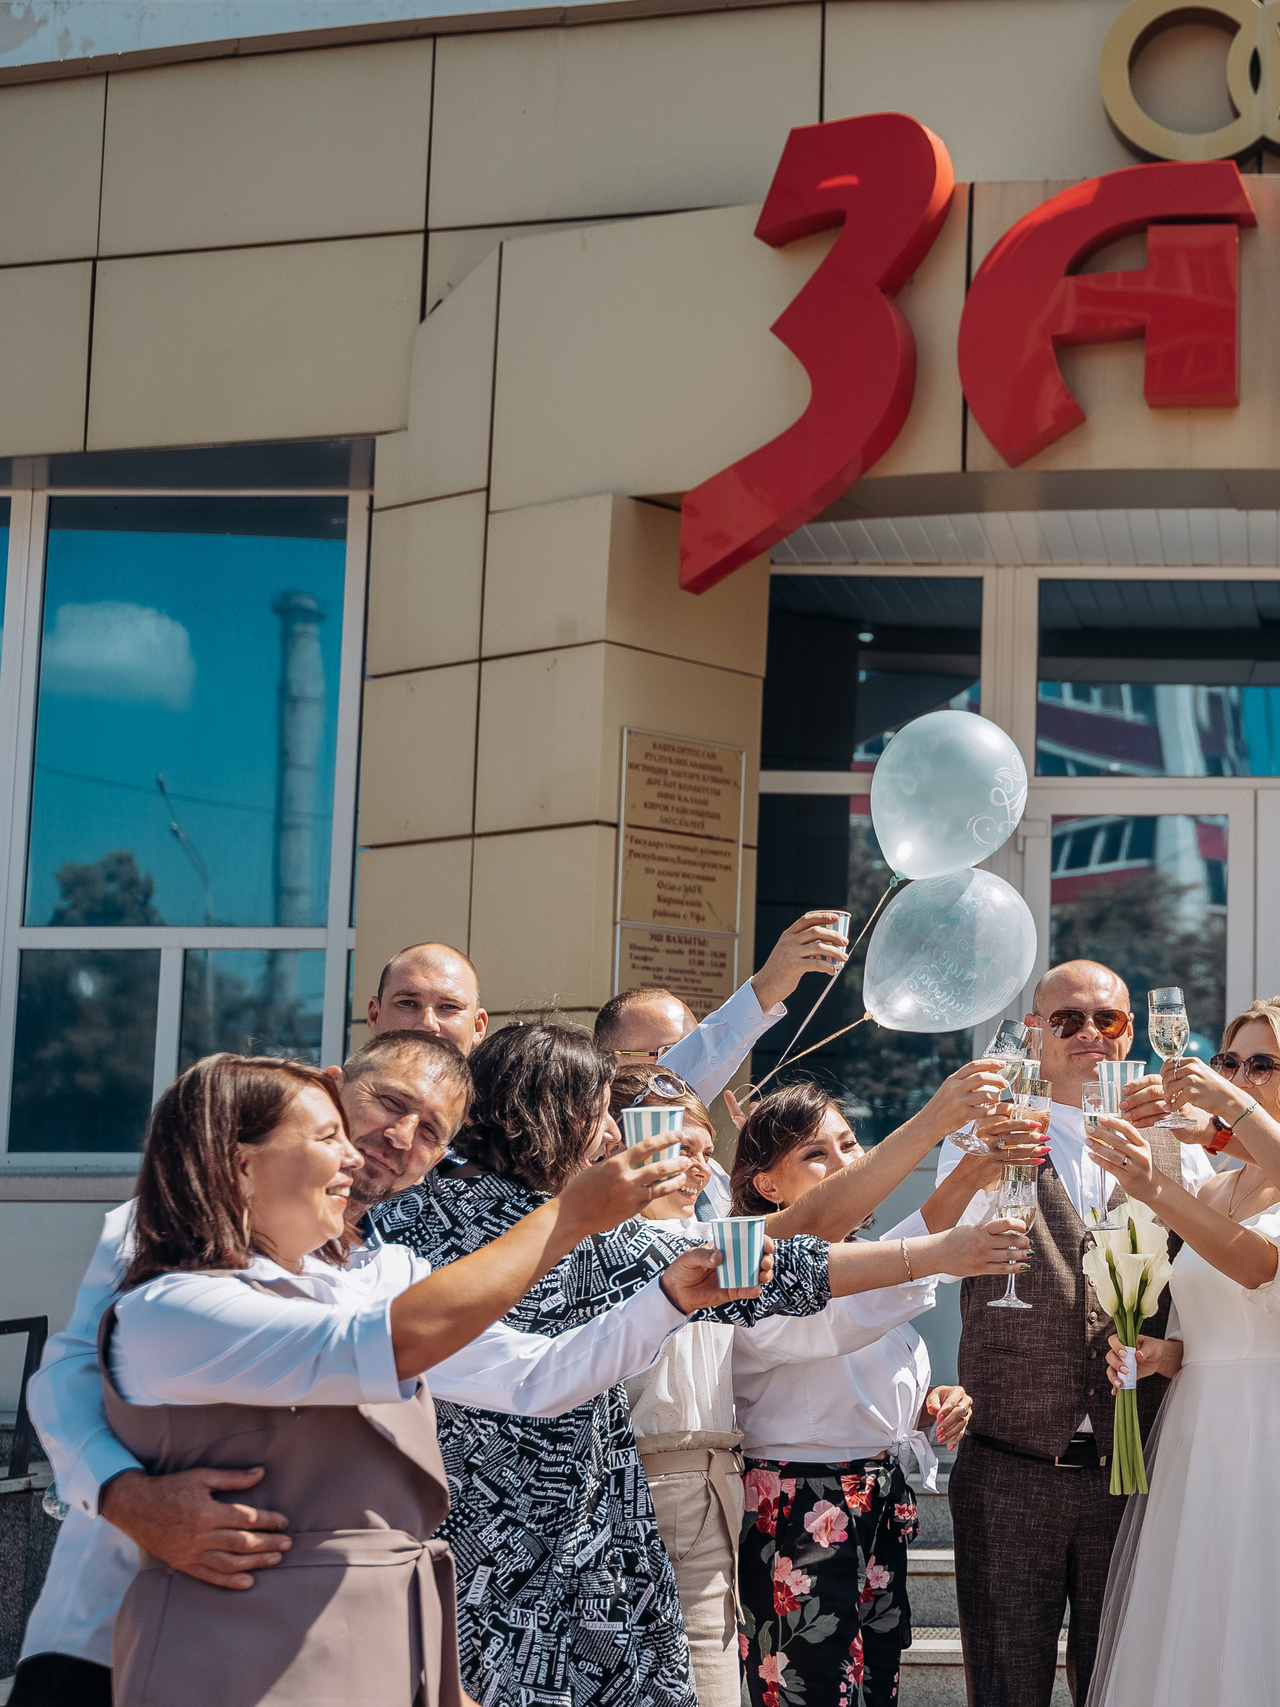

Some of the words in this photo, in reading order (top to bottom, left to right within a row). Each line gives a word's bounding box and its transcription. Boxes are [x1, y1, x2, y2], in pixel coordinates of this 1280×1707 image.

[500, 1203, 525, 1219] Towar
[425, 1240, 452, 1261] DESIGN
[477, 1514, 506, 1540] DESIGN
[483, 1529, 500, 1547] FOR
[578, 1550, 592, 1564] The
[469, 1568, 489, 1602] TODAY
[486, 1562, 516, 1592] The
[541, 1650, 551, 1660] OF
[537, 1660, 548, 1685] SPREAD
[554, 1663, 564, 1689] ALWAYS
[559, 1652, 566, 1662] BE
[578, 1661, 603, 1677] epic.
[600, 1689, 613, 1705] NEVER
[613, 1678, 626, 1690] GIVE
[624, 1668, 631, 1678] UP
